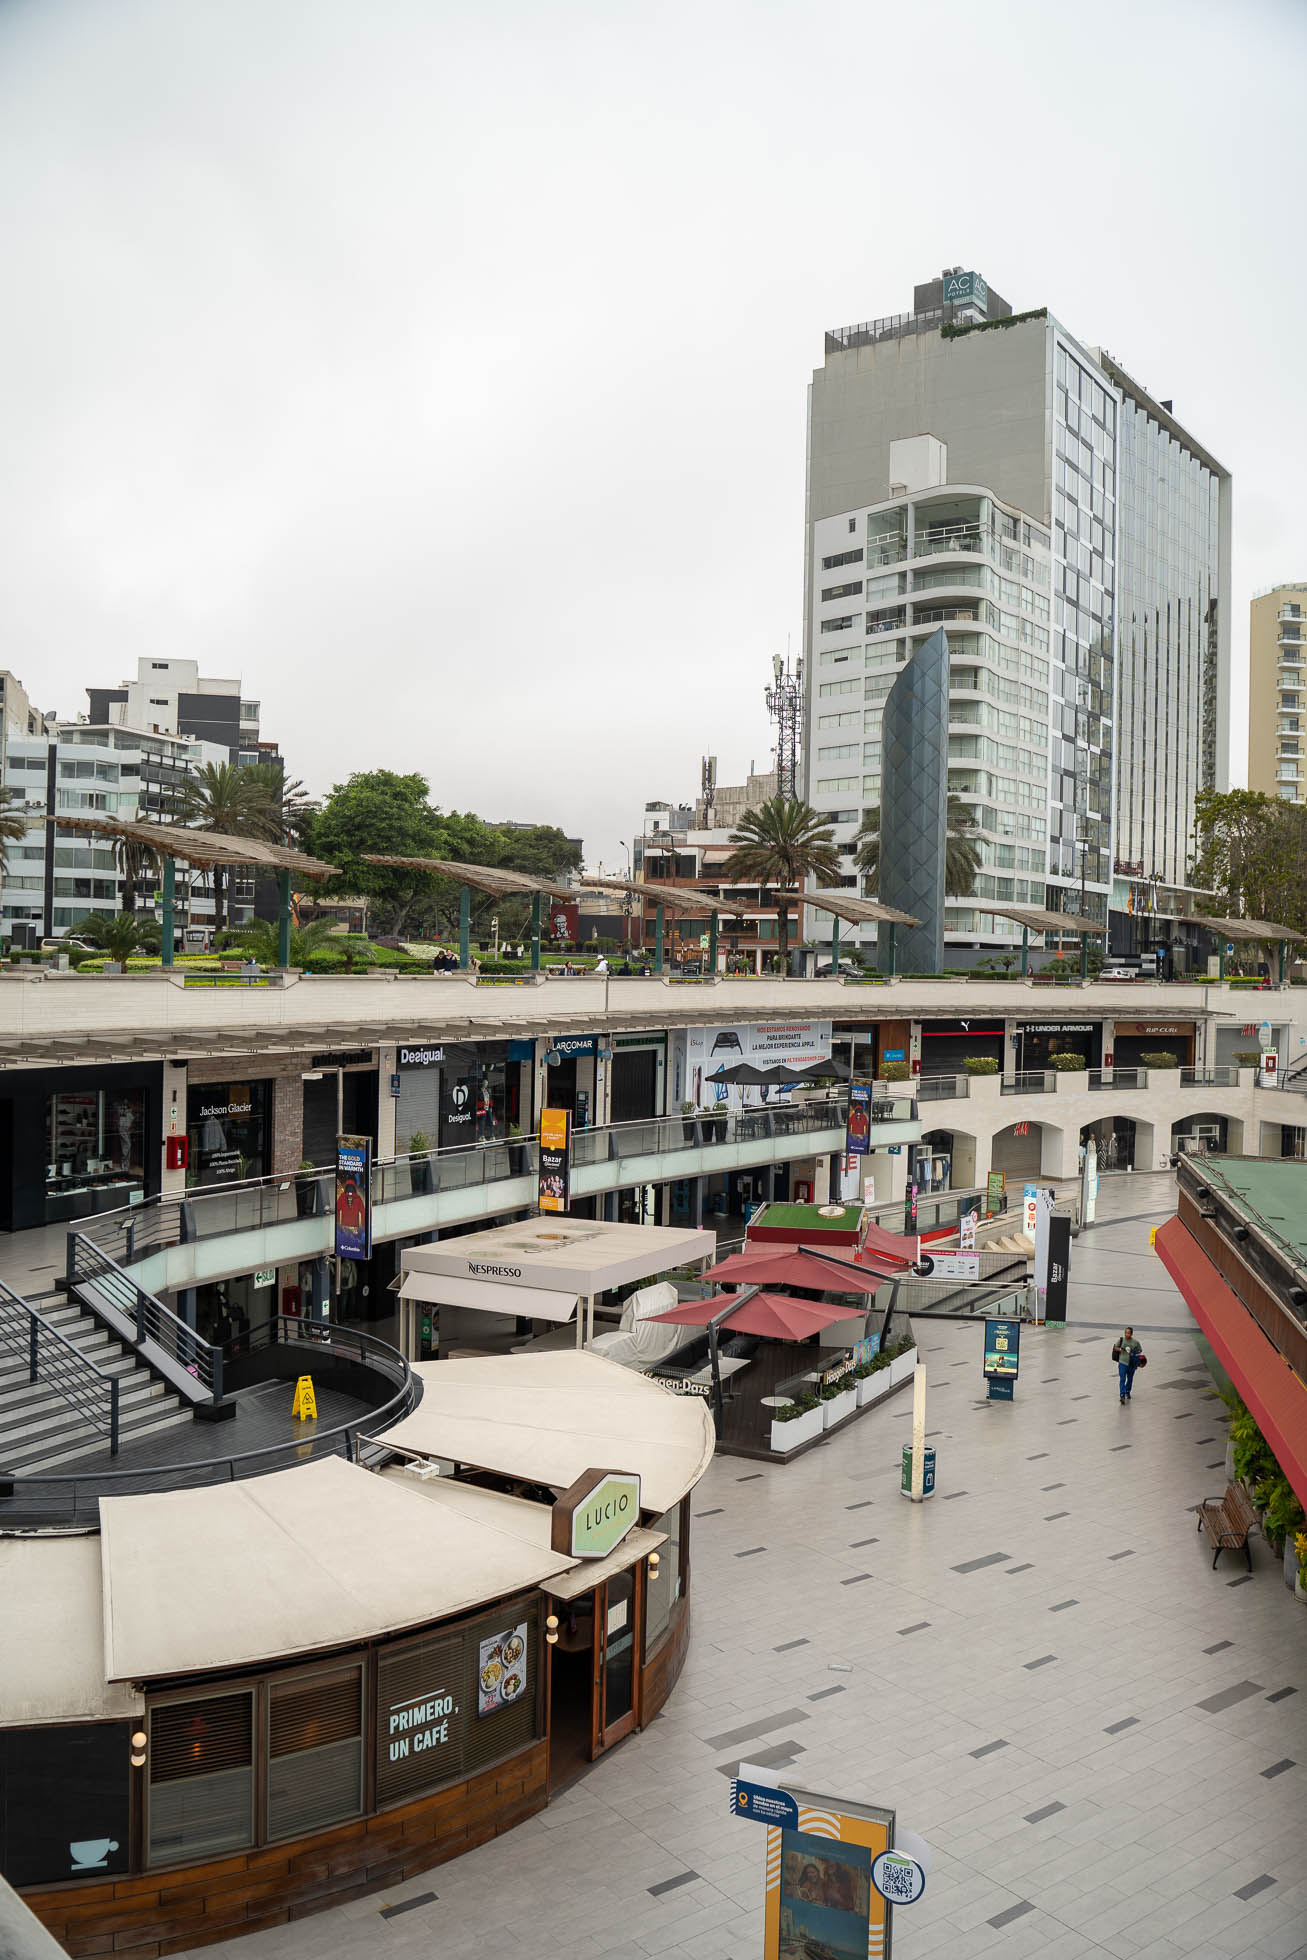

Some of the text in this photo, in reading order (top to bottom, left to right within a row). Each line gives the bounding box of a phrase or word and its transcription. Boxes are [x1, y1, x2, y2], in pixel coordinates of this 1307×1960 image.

[948, 277, 970, 292] AC
[552, 1040, 592, 1053] LARCOMAR
[200, 1102, 252, 1116] Jackson Glacier
[543, 1155, 562, 1163] Bazar
[467, 1261, 522, 1278] NESPRESSO
[586, 1494, 628, 1530] LUCIO
[389, 1695, 459, 1735] PRIMERO,
[389, 1718, 449, 1761] UN CAFÉ
